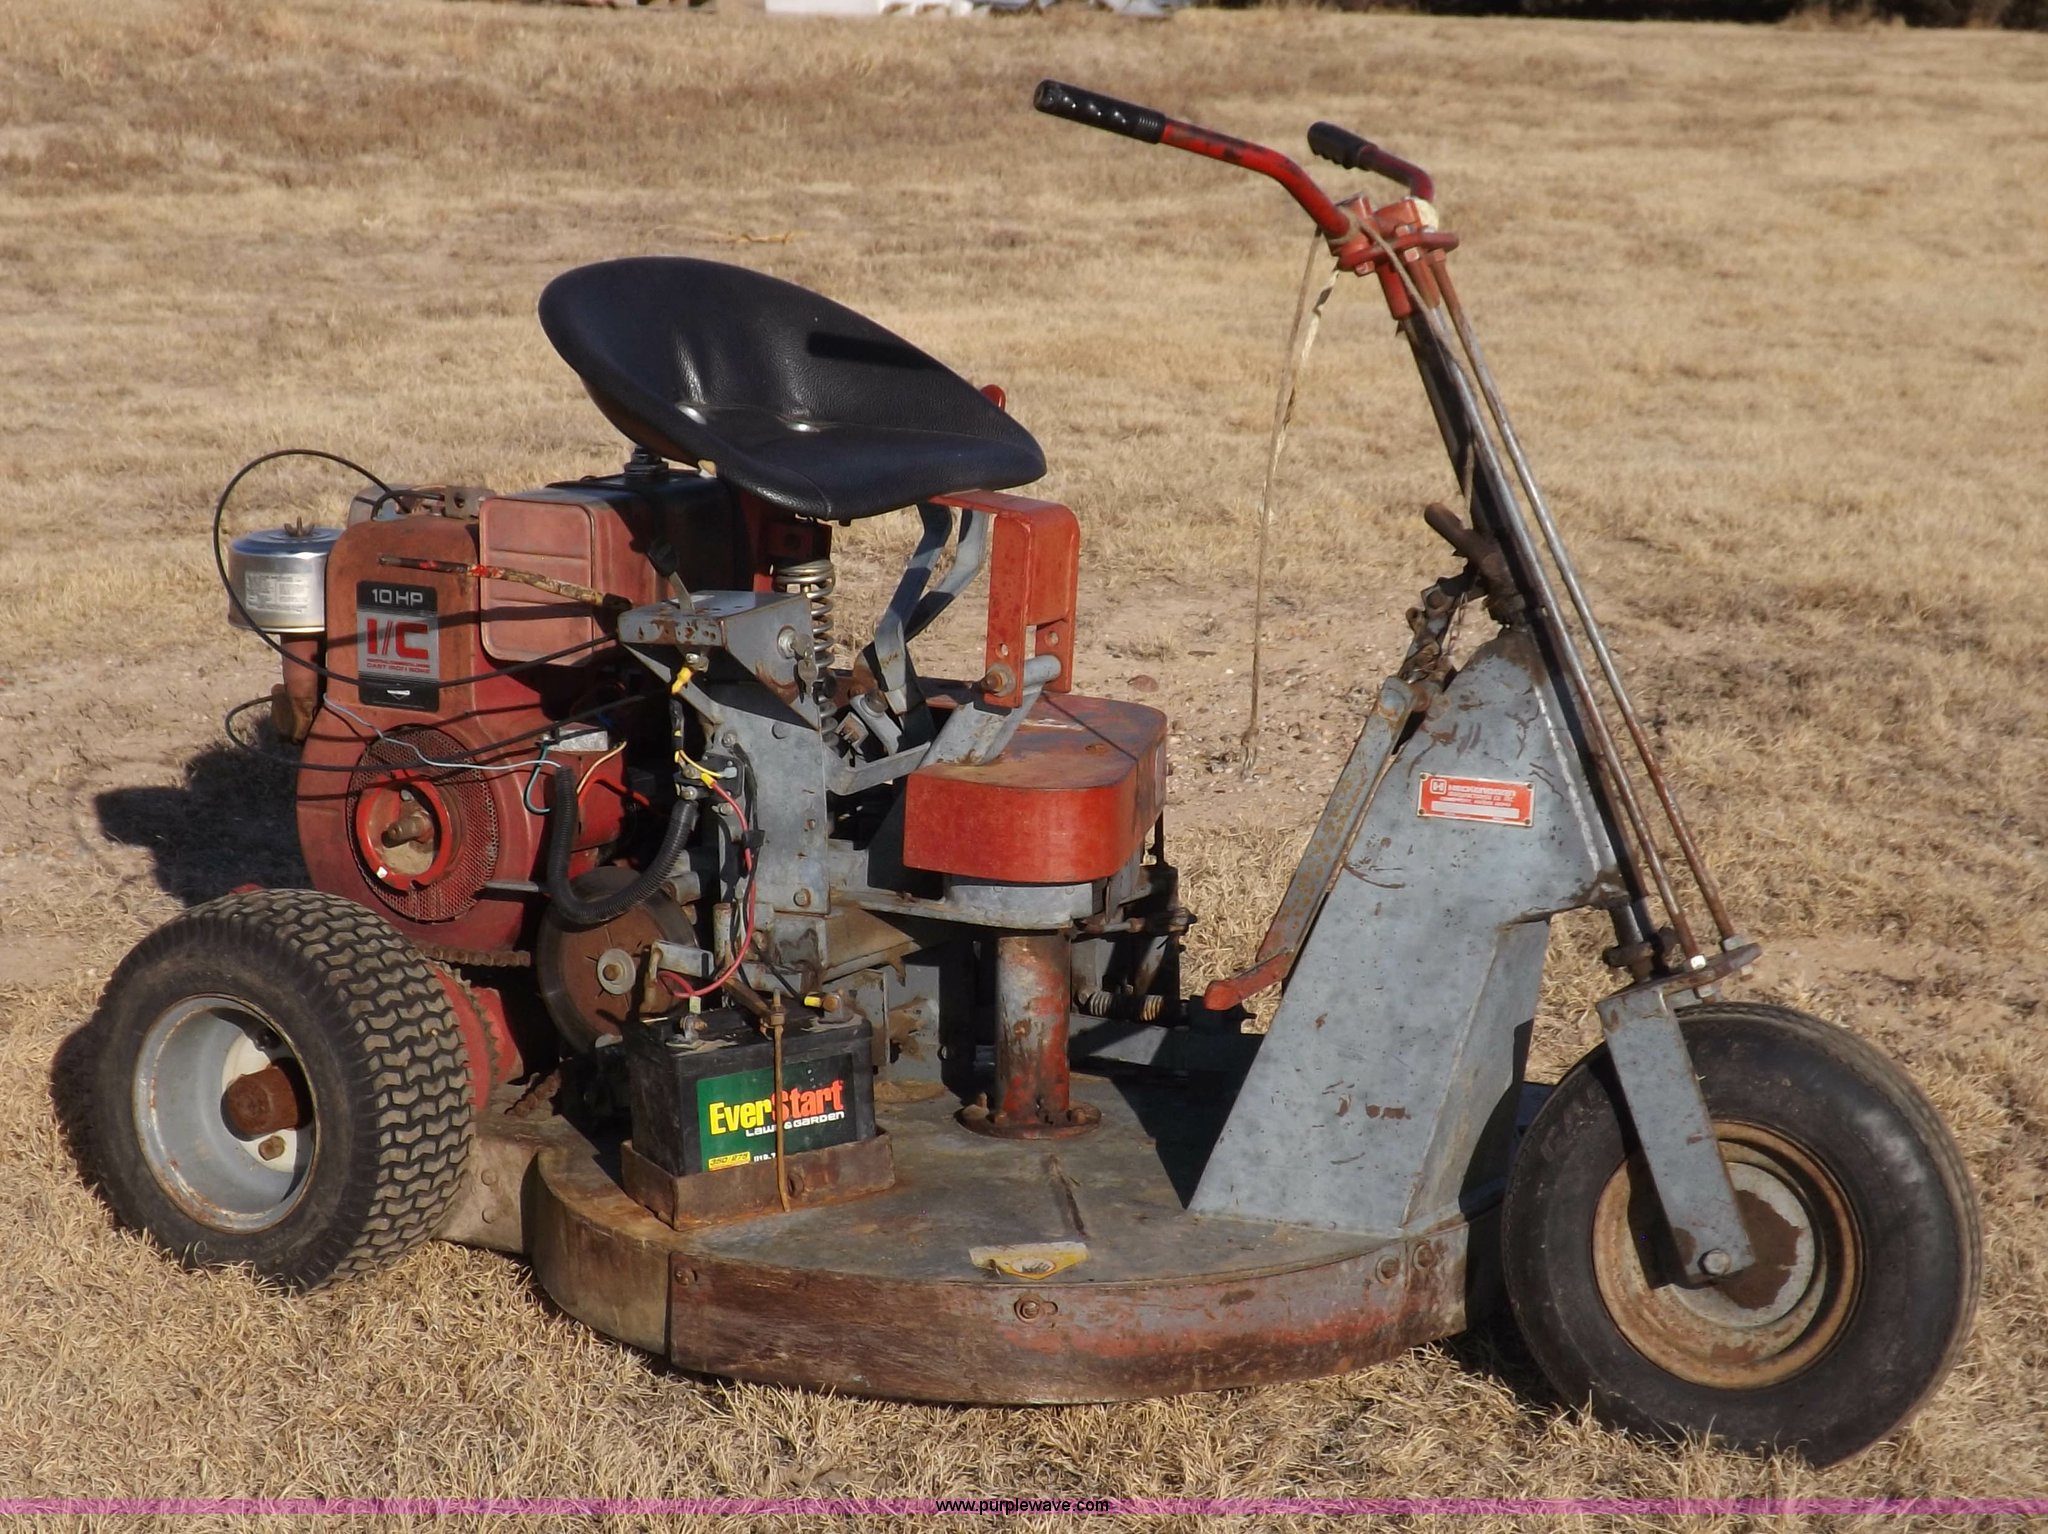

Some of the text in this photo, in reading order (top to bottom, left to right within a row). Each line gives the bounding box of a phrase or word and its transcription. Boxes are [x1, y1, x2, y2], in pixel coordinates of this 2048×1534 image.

[372, 589, 423, 605] 10 HP
[367, 619, 429, 659] I/C
[709, 1080, 844, 1135] EverStart
